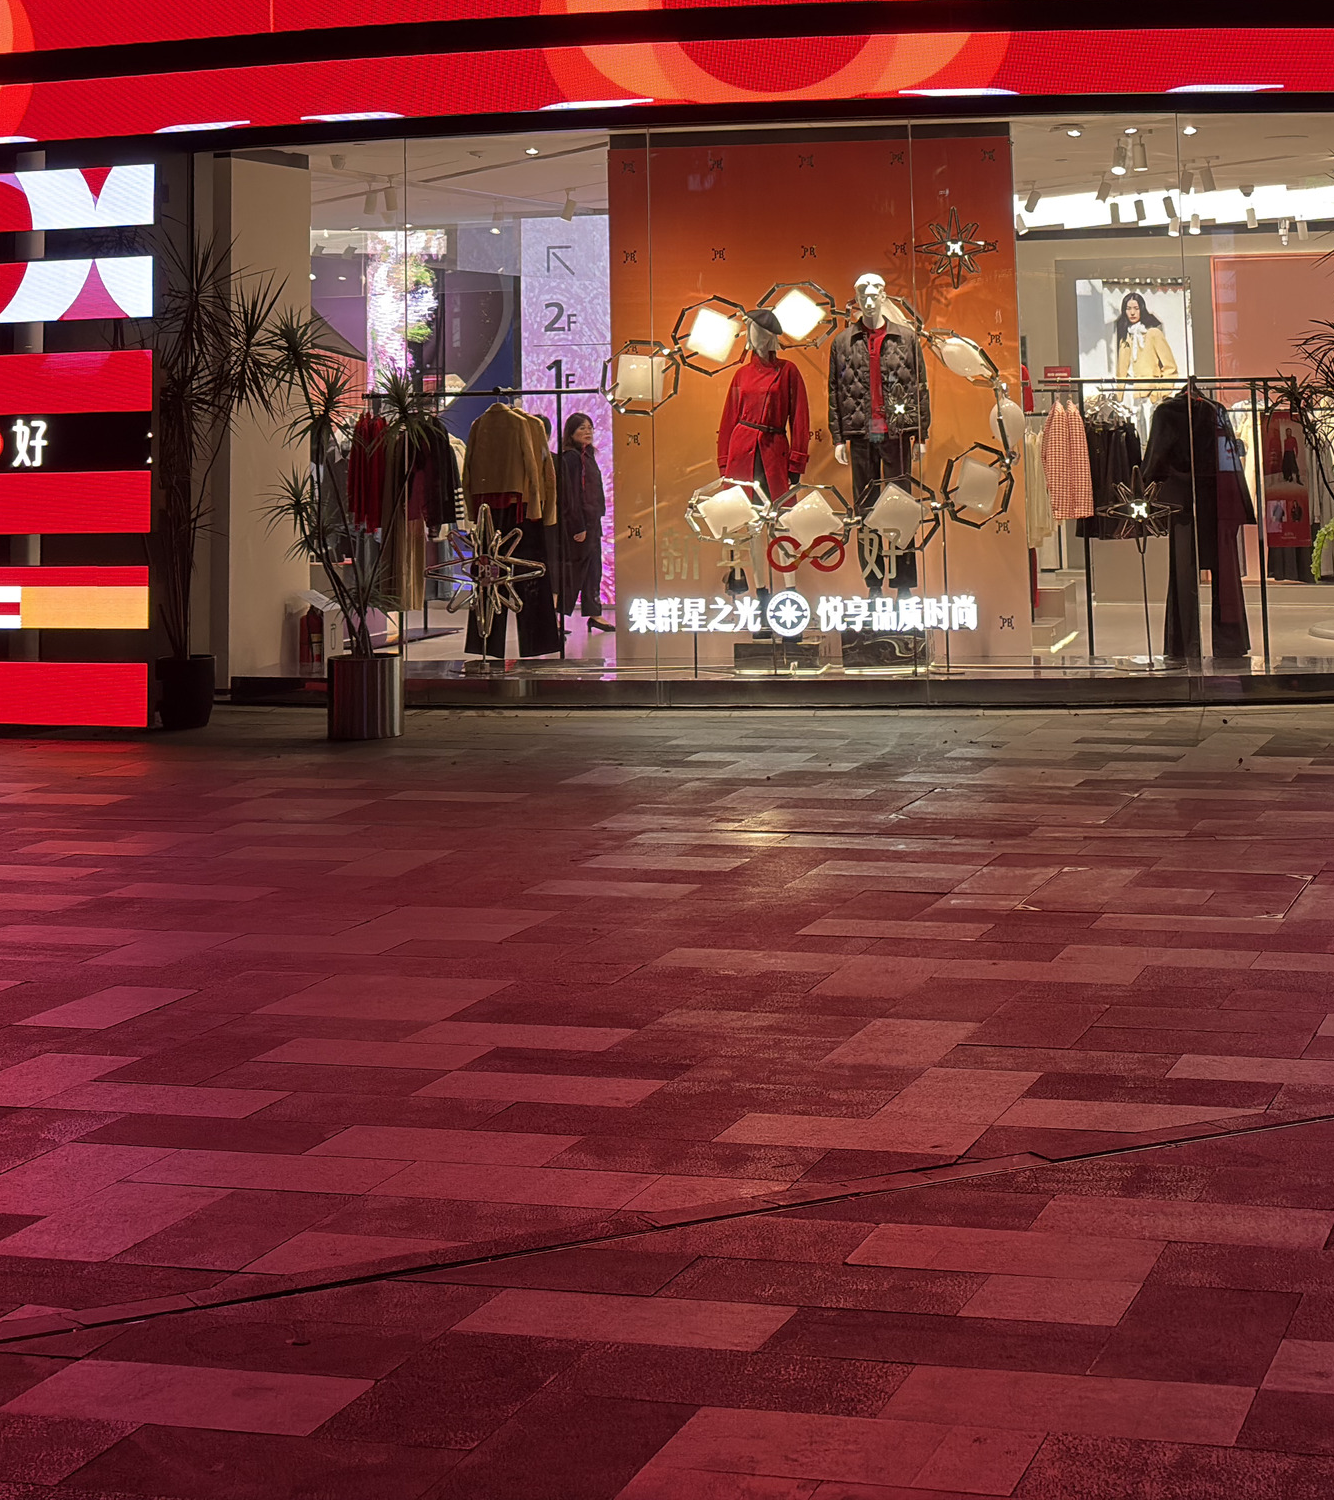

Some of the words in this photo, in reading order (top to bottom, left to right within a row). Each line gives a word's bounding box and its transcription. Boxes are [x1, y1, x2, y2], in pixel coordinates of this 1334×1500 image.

[544, 301, 577, 333] 2F
[545, 359, 576, 390] 1F
[628, 596, 762, 634] 集群星之光
[816, 595, 979, 632] 悦享品质时尚
